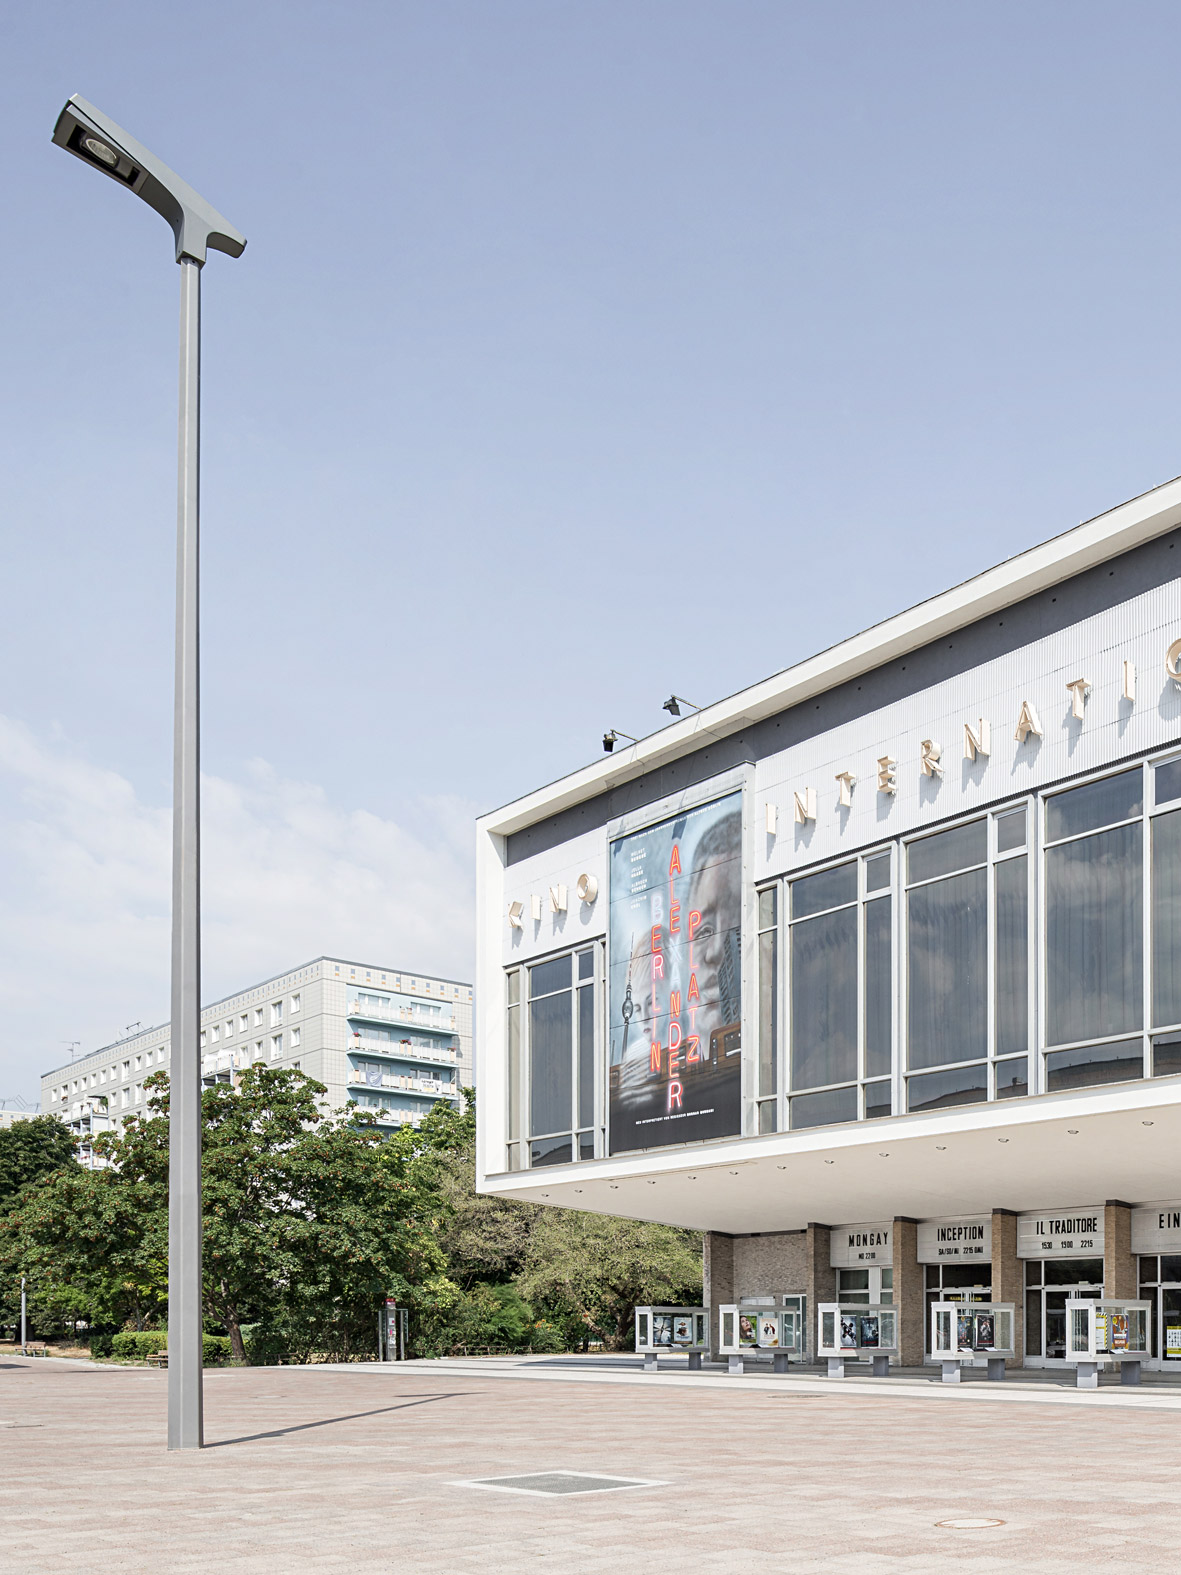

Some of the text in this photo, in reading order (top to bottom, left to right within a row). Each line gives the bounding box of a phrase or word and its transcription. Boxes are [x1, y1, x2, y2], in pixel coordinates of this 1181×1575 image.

[508, 873, 598, 929] KINO
[651, 894, 664, 1072] BERLIN
[668, 844, 683, 1109] ALEXANDER
[687, 910, 701, 1063] PLATZ
[937, 1225, 984, 1242] INCEPTION
[1036, 1217, 1098, 1236] IL TRADITORE
[848, 1231, 889, 1248] MONGAY
[1041, 1239, 1094, 1250] 1530 1900 2215
[963, 1246, 974, 1254] 2215
